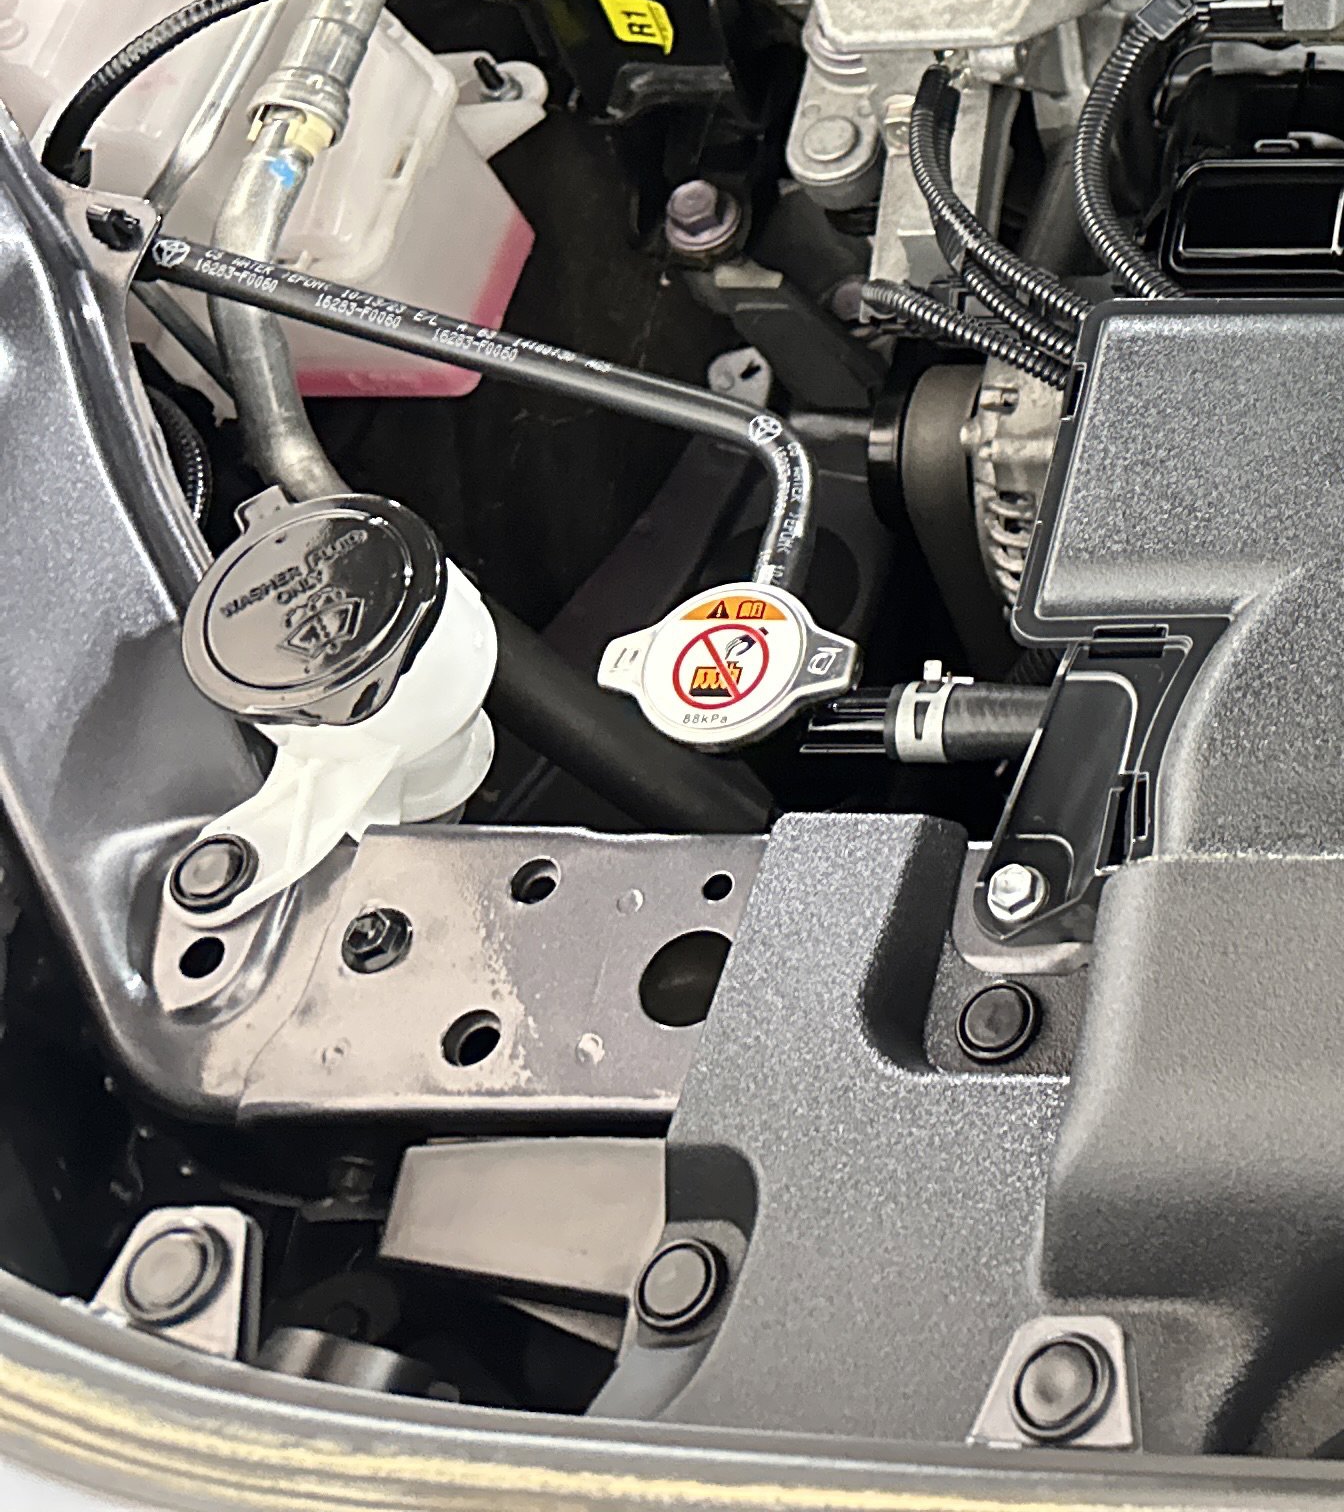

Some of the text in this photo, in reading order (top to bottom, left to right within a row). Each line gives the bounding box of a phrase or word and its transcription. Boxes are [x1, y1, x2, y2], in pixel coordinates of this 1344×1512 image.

[621, 10, 656, 38] R1
[219, 564, 303, 618] WASHER
[275, 566, 326, 605] ONLY
[683, 713, 728, 725] 88kPa
